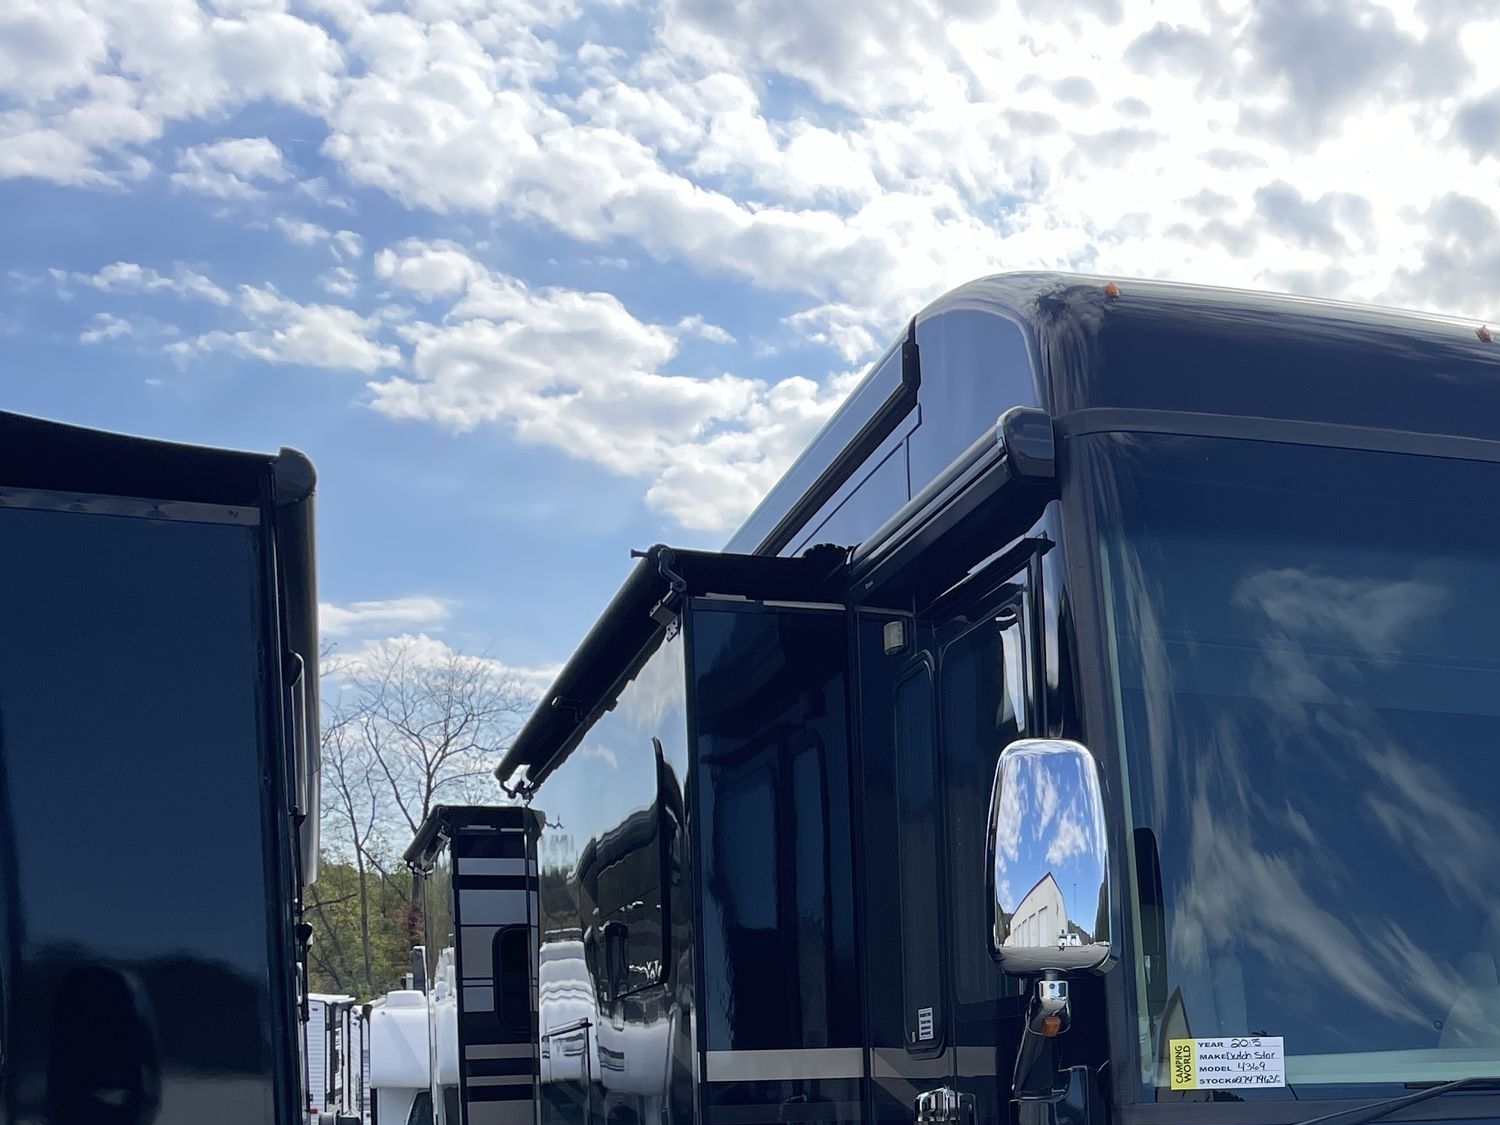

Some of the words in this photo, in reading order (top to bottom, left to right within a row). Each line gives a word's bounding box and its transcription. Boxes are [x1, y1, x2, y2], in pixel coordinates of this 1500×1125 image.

[1175, 1045, 1184, 1084] CAMPING
[1182, 1045, 1191, 1083] WORLD
[1237, 1061, 1265, 1071] 4369
[1254, 1051, 1275, 1060] Star
